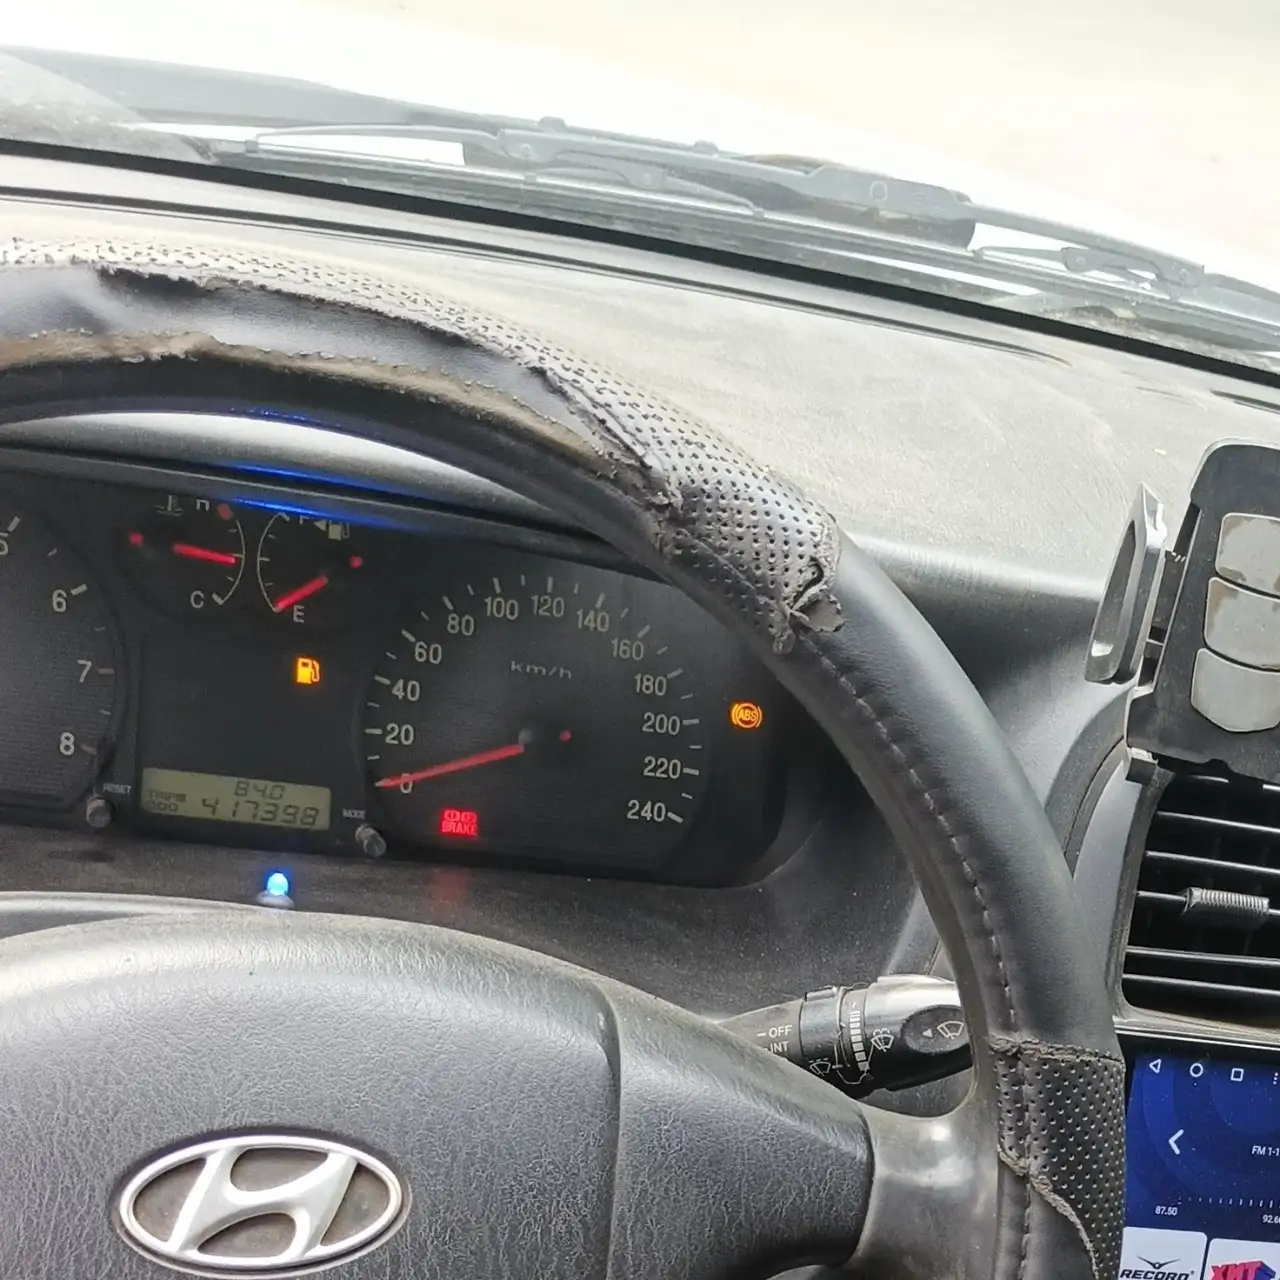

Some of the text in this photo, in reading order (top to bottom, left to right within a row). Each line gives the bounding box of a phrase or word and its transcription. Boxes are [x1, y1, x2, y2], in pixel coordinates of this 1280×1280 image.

[51, 589, 67, 613] 6
[190, 591, 205, 609] C
[485, 597, 519, 620] 100
[531, 596, 565, 618] 120
[293, 605, 305, 624] E
[446, 615, 475, 636] 80
[576, 609, 610, 632] 140
[414, 644, 442, 664] 60
[611, 638, 644, 661] 160
[77, 659, 92, 683] 7
[510, 660, 573, 681] km/h
[392, 679, 420, 702] 40
[634, 673, 667, 696] 180
[385, 724, 414, 746] 20
[642, 712, 681, 736] 200
[59, 731, 75, 756] 8
[643, 756, 681, 779] 220
[627, 800, 667, 823] 240
[768, 1024, 793, 1039] OFF
[1251, 1145, 1280, 1157] FM 1-1
[1155, 1205, 1178, 1216] 87.50
